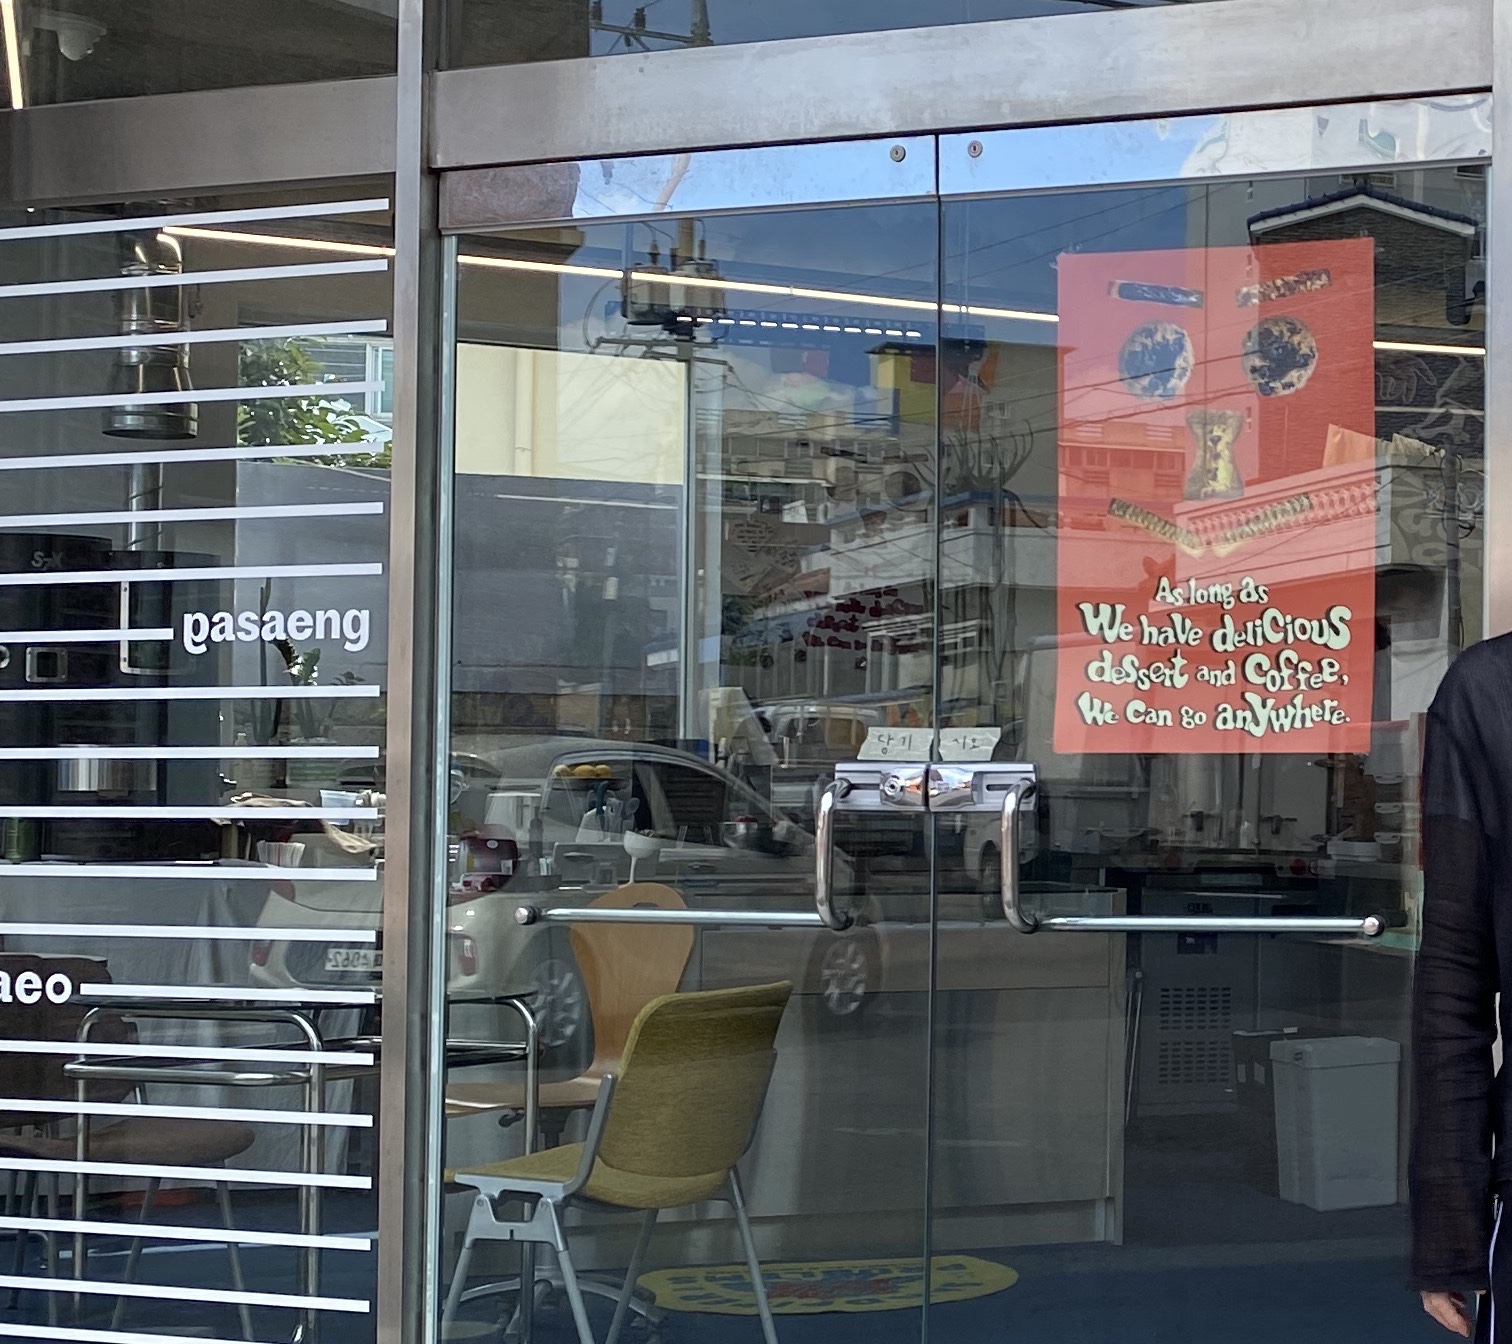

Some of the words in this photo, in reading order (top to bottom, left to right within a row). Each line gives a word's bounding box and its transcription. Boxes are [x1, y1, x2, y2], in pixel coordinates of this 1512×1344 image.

[1155, 575, 1183, 605] As
[1188, 577, 1236, 610] long
[1239, 575, 1269, 605] as
[183, 607, 371, 653] pasaeng
[1078, 602, 1134, 644] We
[1196, 659, 1236, 686] and
[1077, 691, 1120, 726] We
[1180, 705, 1207, 730] go
[877, 732, 913, 756] 당기
[952, 735, 980, 750] 시오
